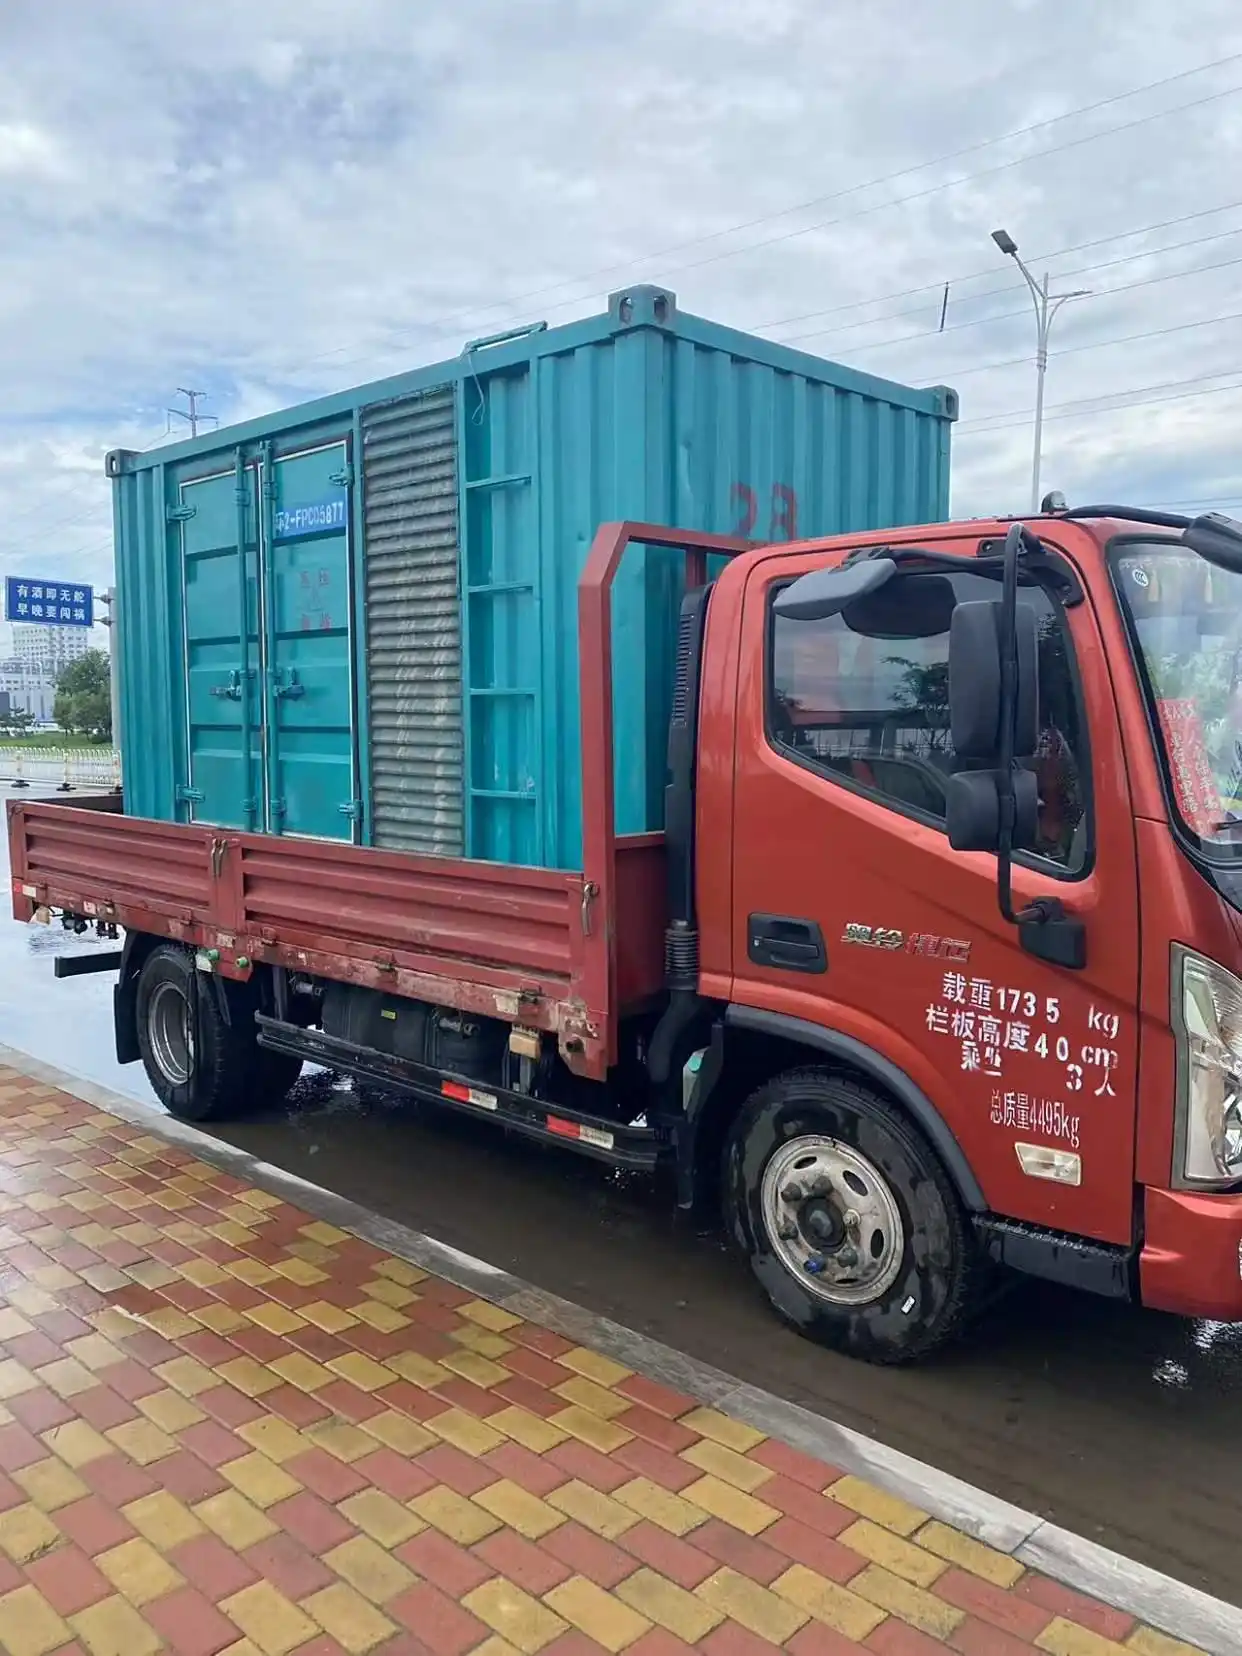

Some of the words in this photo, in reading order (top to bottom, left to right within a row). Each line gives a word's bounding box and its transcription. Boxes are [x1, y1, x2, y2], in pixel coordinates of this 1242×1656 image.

[16, 602, 85, 620] 早晚要闯祸
[990, 1089, 1081, 1149] 总质量4495kg
